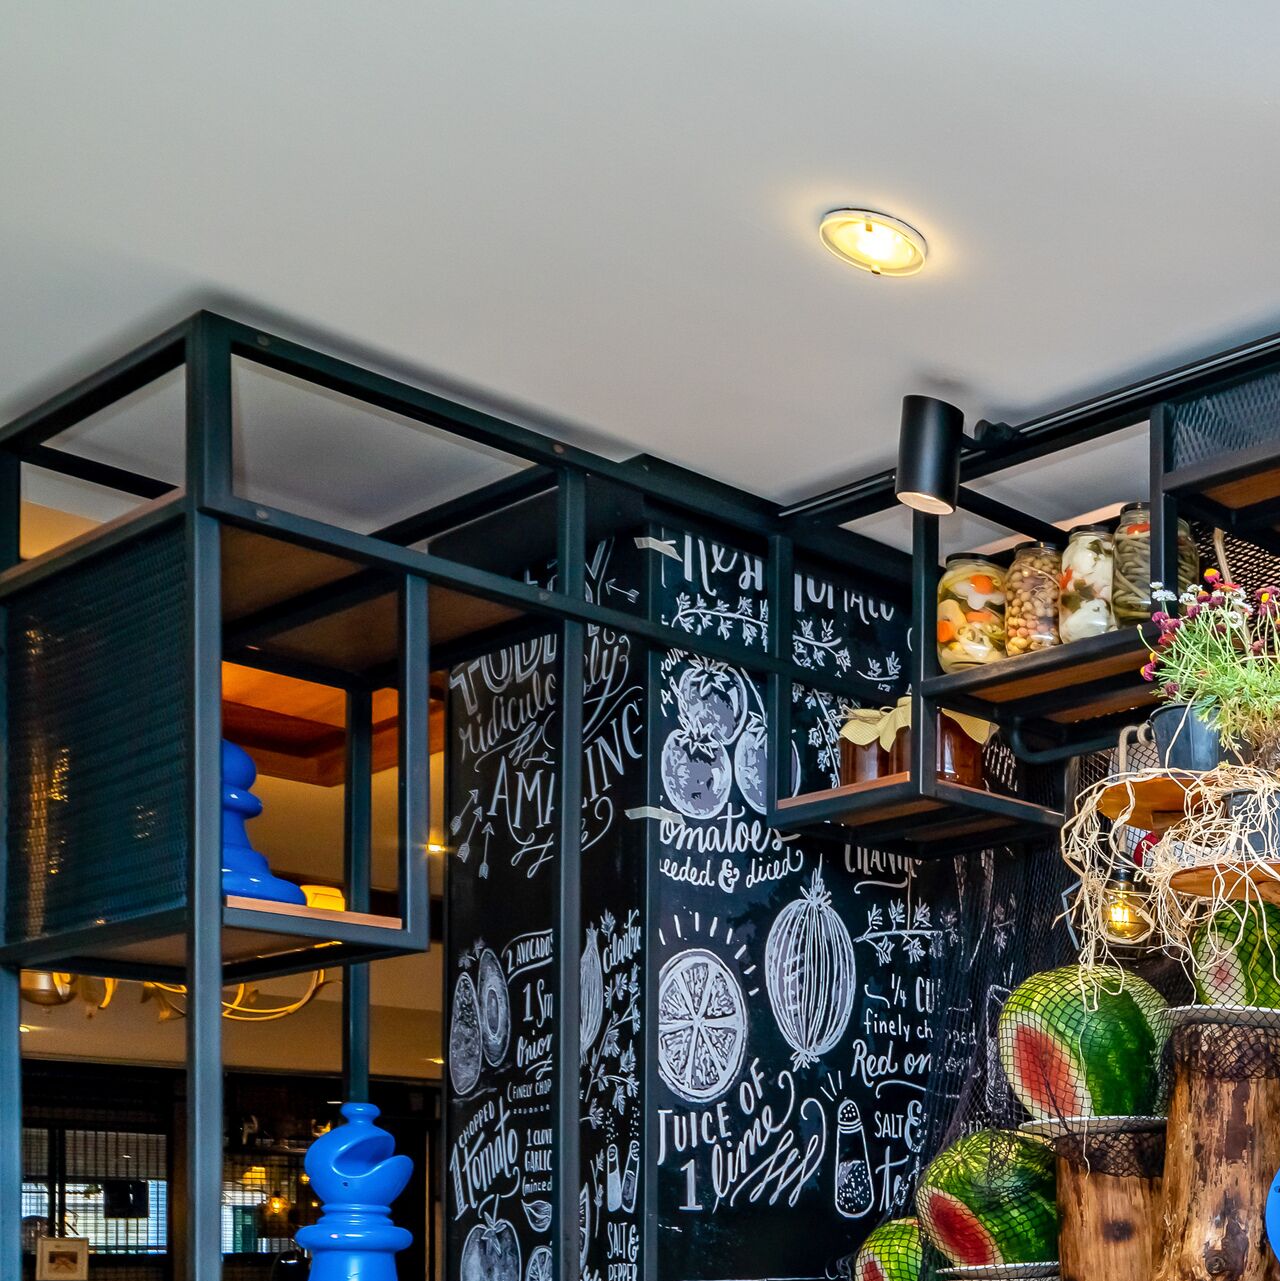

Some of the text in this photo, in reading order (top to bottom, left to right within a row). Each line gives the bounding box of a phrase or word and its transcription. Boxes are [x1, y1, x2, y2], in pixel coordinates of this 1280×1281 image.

[660, 803, 800, 853] omatoes
[660, 856, 715, 887] eeded
[863, 1008, 910, 1042] finely
[850, 1038, 898, 1088] Red
[657, 1057, 765, 1166] JUICE OF
[874, 1110, 904, 1139] SALT
[678, 1158, 703, 1211] 1
[607, 1221, 627, 1259] SALT
